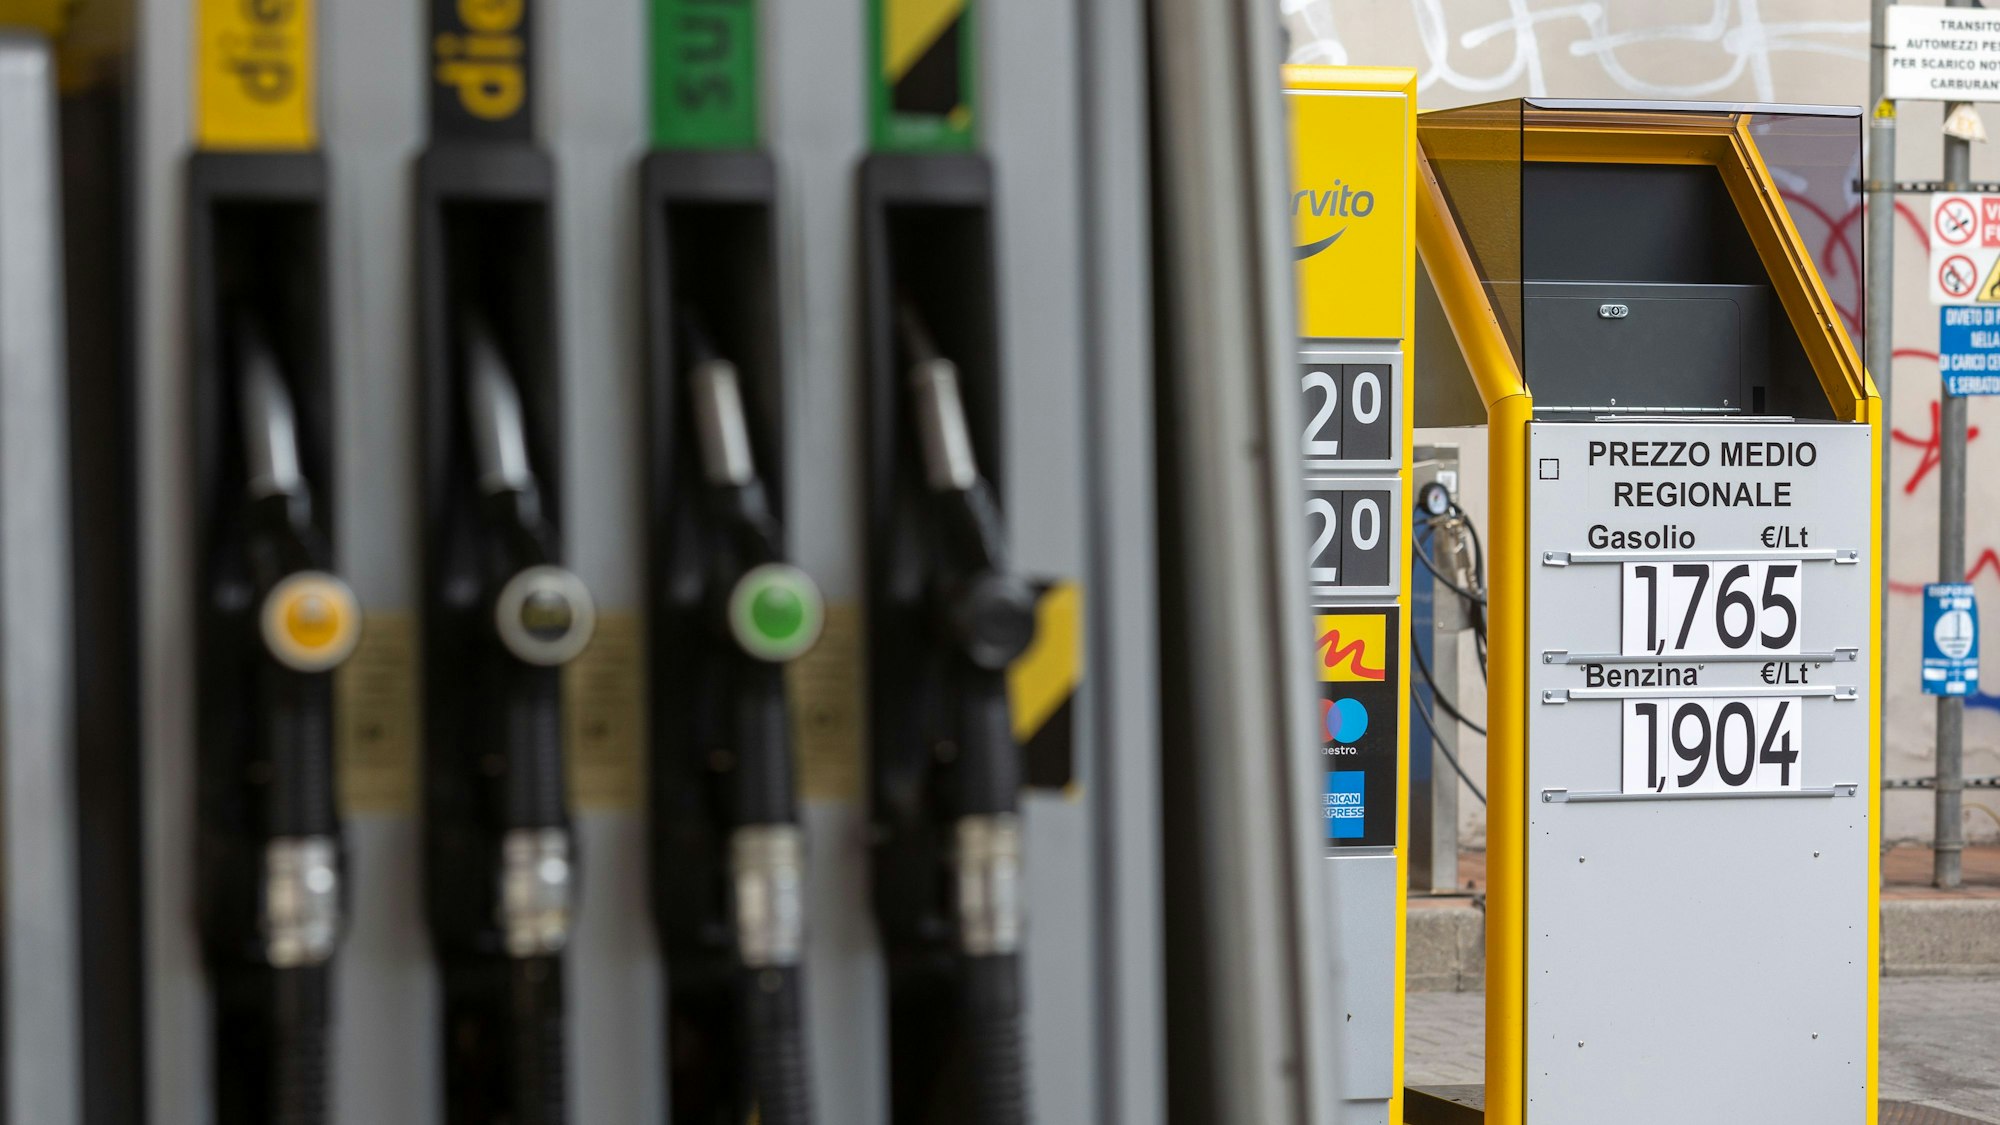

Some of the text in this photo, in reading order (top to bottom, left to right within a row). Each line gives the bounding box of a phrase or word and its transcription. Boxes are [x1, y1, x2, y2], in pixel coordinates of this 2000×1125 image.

[1940, 20, 2000, 32] TRANSITO
[1906, 39, 1978, 51] AUTOMEZZI
[675, 0, 734, 112] su
[1893, 58, 1916, 68] PER
[1921, 59, 1976, 70] SCARICO
[1930, 79, 2000, 89] CARBURAN
[1290, 178, 1374, 217] rvito
[1946, 308, 1982, 326] DIVIETO
[1984, 308, 1995, 326] DI
[1940, 354, 1950, 371] DI
[1951, 354, 1986, 371] CARICO
[1588, 441, 1817, 467] PREZZO MEDIO
[1614, 482, 1792, 507] REGIONALE
[1587, 524, 1808, 549] Gasolio €/Lt
[1635, 564, 1798, 655] 1,765
[1585, 662, 1808, 688] Benzina €/Lt
[1320, 745, 1357, 755] aestro
[1635, 701, 1799, 792] 1,904
[1321, 794, 1360, 804] ERICAN
[1321, 807, 1364, 817] XPRESS
